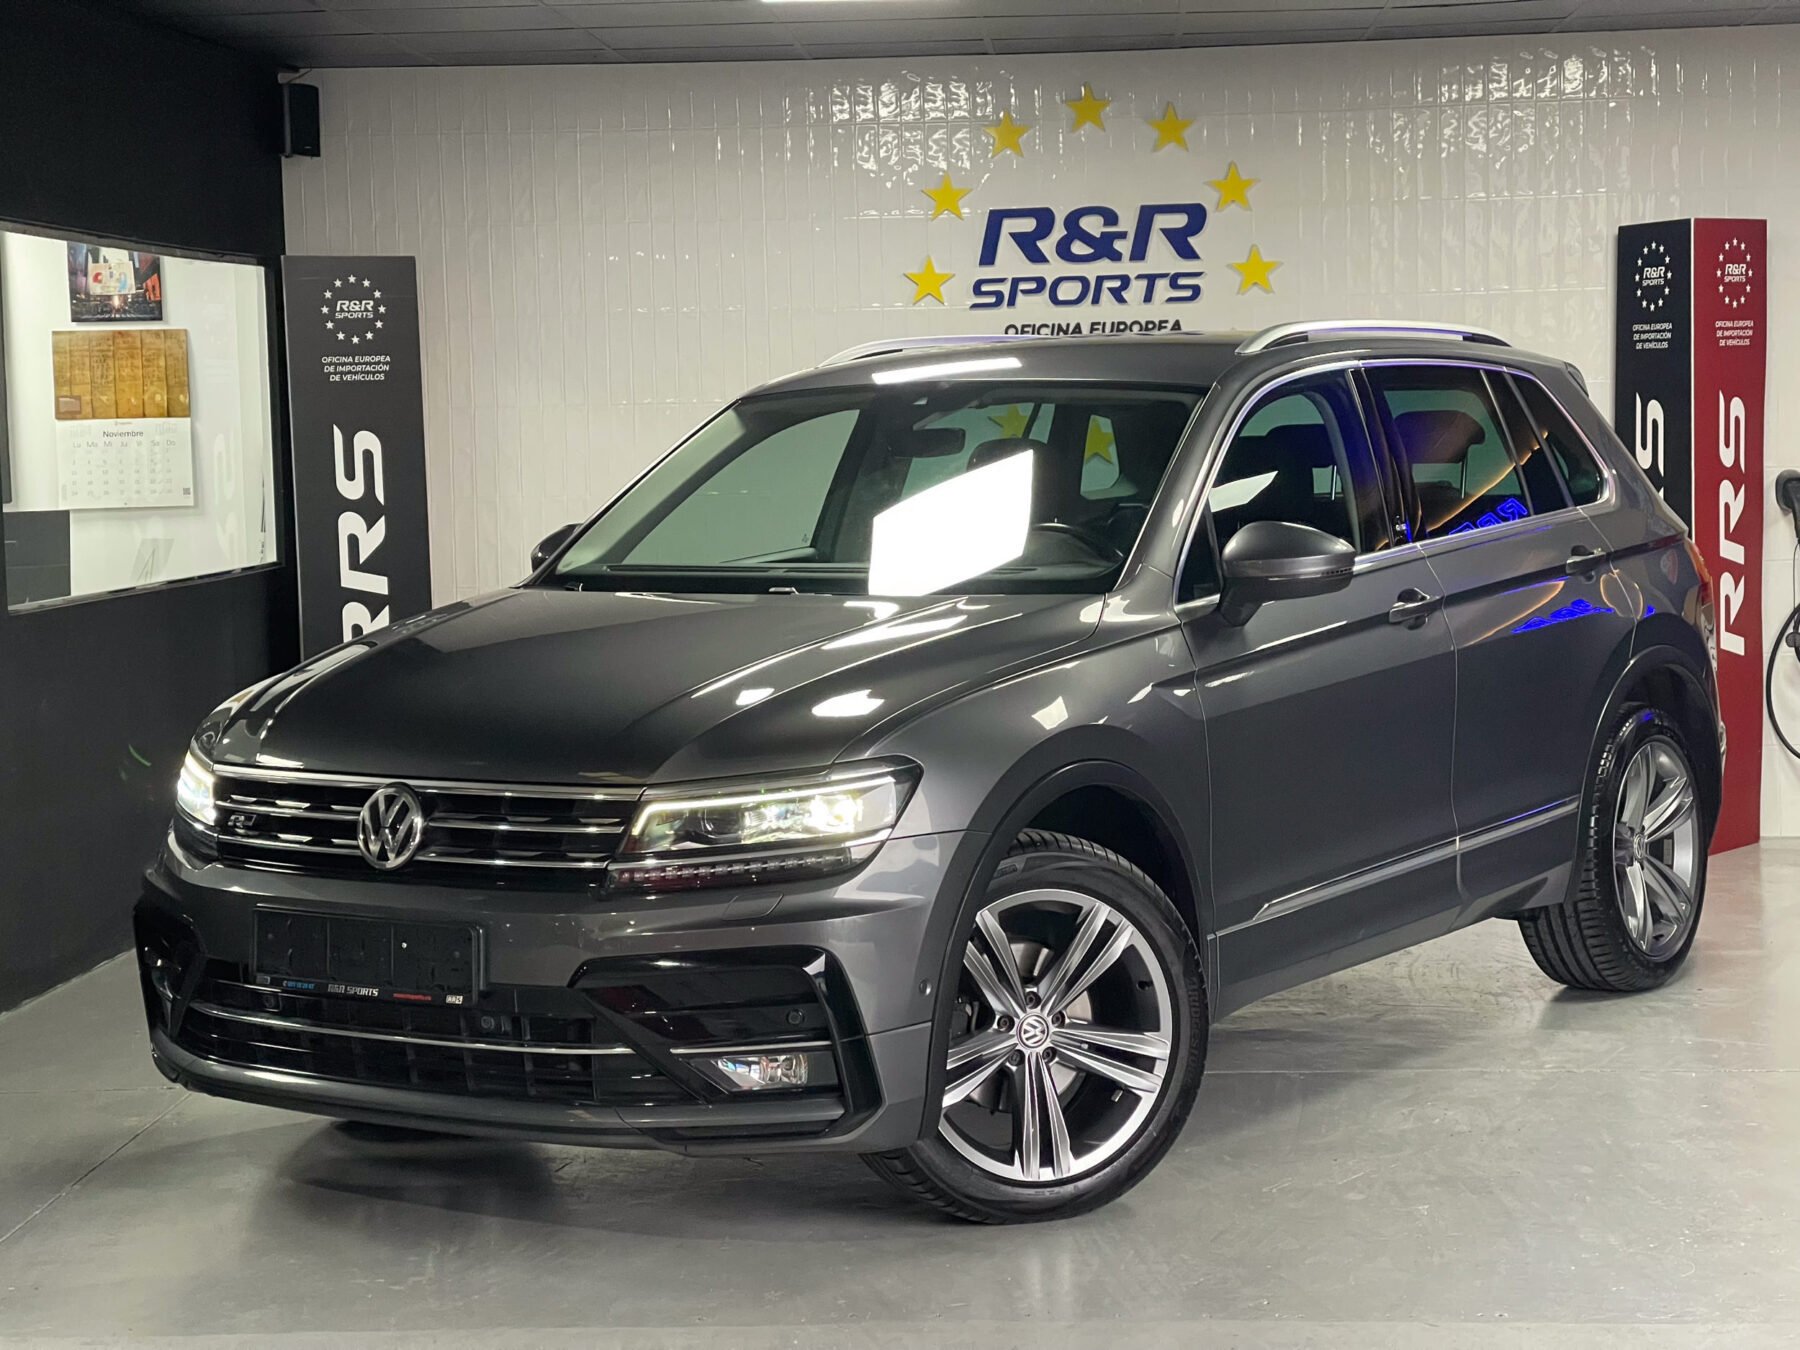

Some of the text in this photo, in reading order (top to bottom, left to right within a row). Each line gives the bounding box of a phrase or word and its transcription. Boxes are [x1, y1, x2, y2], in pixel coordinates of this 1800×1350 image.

[978, 203, 1207, 266] R&R
[1643, 266, 1665, 279] R&R
[1725, 264, 1747, 275] R&R
[1642, 278, 1665, 287] SPORTS
[1724, 275, 1746, 283] SPORTS
[969, 271, 1205, 309] SPORTS
[336, 300, 374, 312] R&R
[335, 311, 374, 319] SPORTS
[1004, 322, 1083, 336] OFICINA
[1632, 322, 1673, 332] OFICINA EUROPEA
[1715, 320, 1733, 328] OFICINA
[321, 355, 391, 364] OFICINA EUROPEA
[324, 363, 390, 373] DE IMPORTACIÓN
[329, 373, 385, 382] DE VEHÍCULOS
[103, 430, 144, 438] Noviembre
[1718, 390, 1745, 656] RRS
[346, 986, 379, 997] SPORTS
